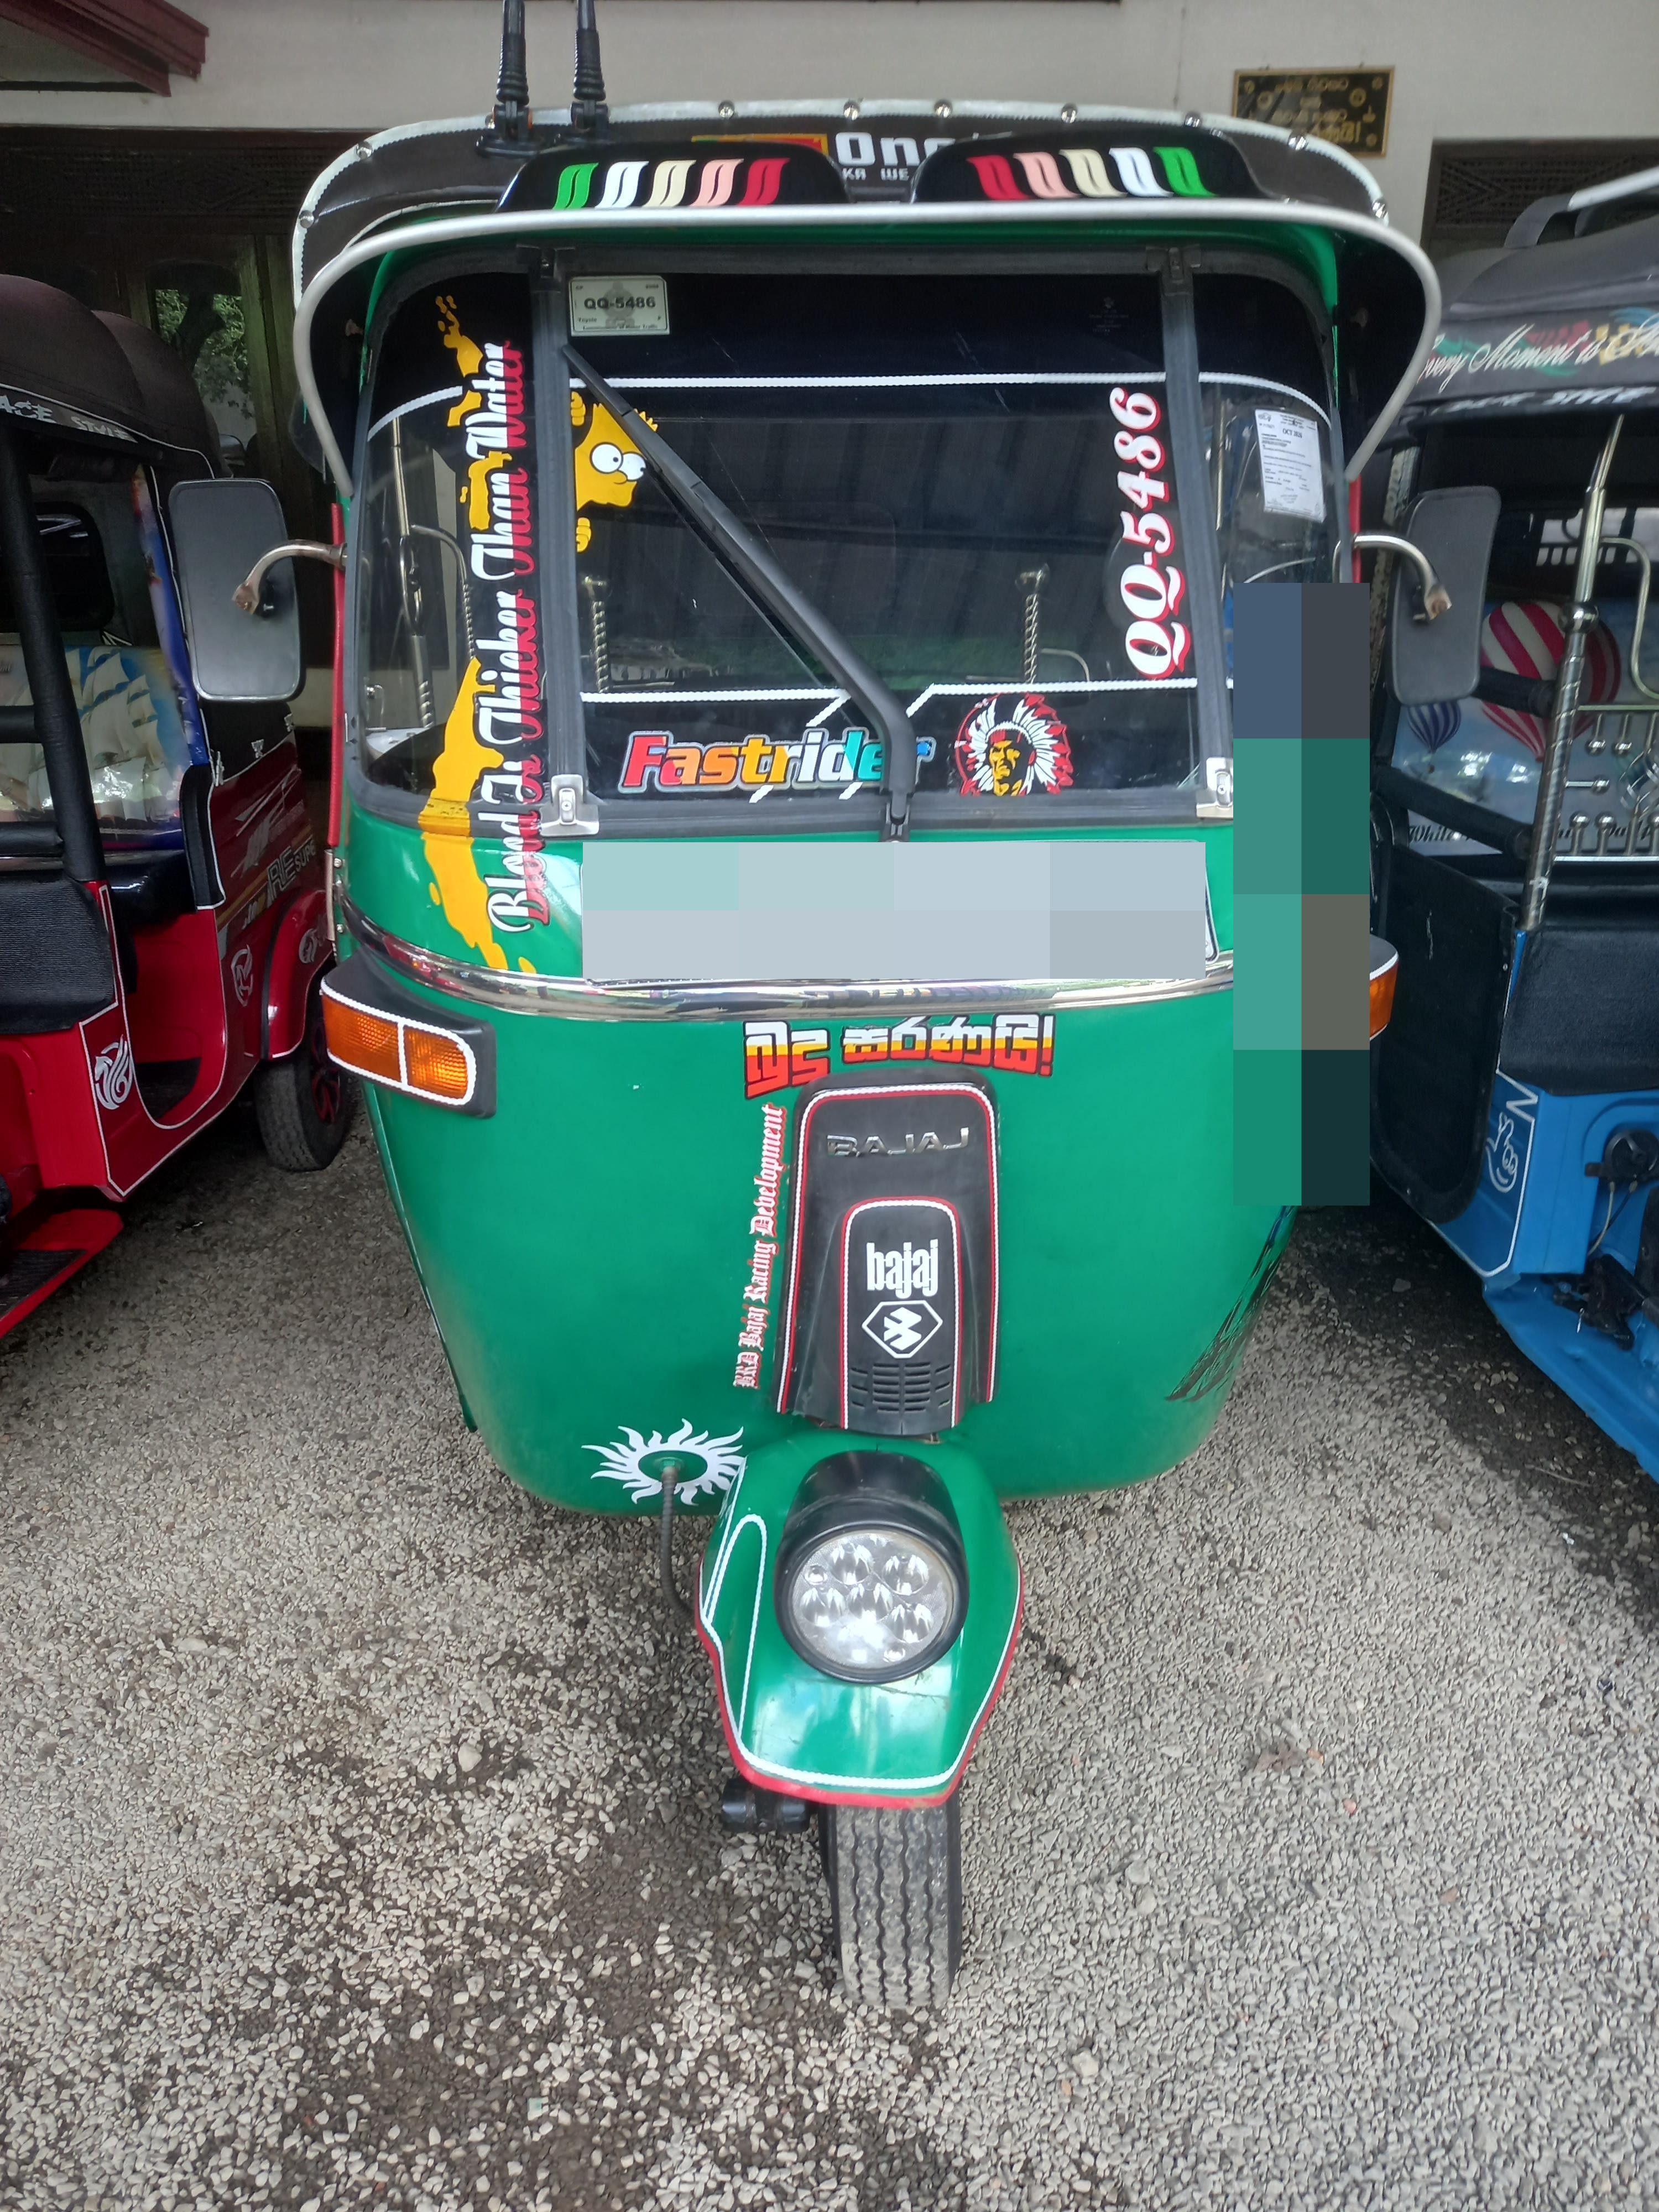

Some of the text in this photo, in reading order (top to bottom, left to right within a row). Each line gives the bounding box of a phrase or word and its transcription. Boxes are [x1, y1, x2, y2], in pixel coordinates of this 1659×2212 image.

[584, 296, 656, 310] QQ-5486
[1109, 387, 1191, 679] QQ-5486
[465, 340, 549, 932] Blood Is Thicker Than Water
[749, 1102, 787, 1238] Development
[827, 1127, 969, 1157] BAJAJ
[743, 1239, 779, 1303] Racing
[866, 1239, 940, 1298] bajaj
[737, 1303, 769, 1353] Bajaj
